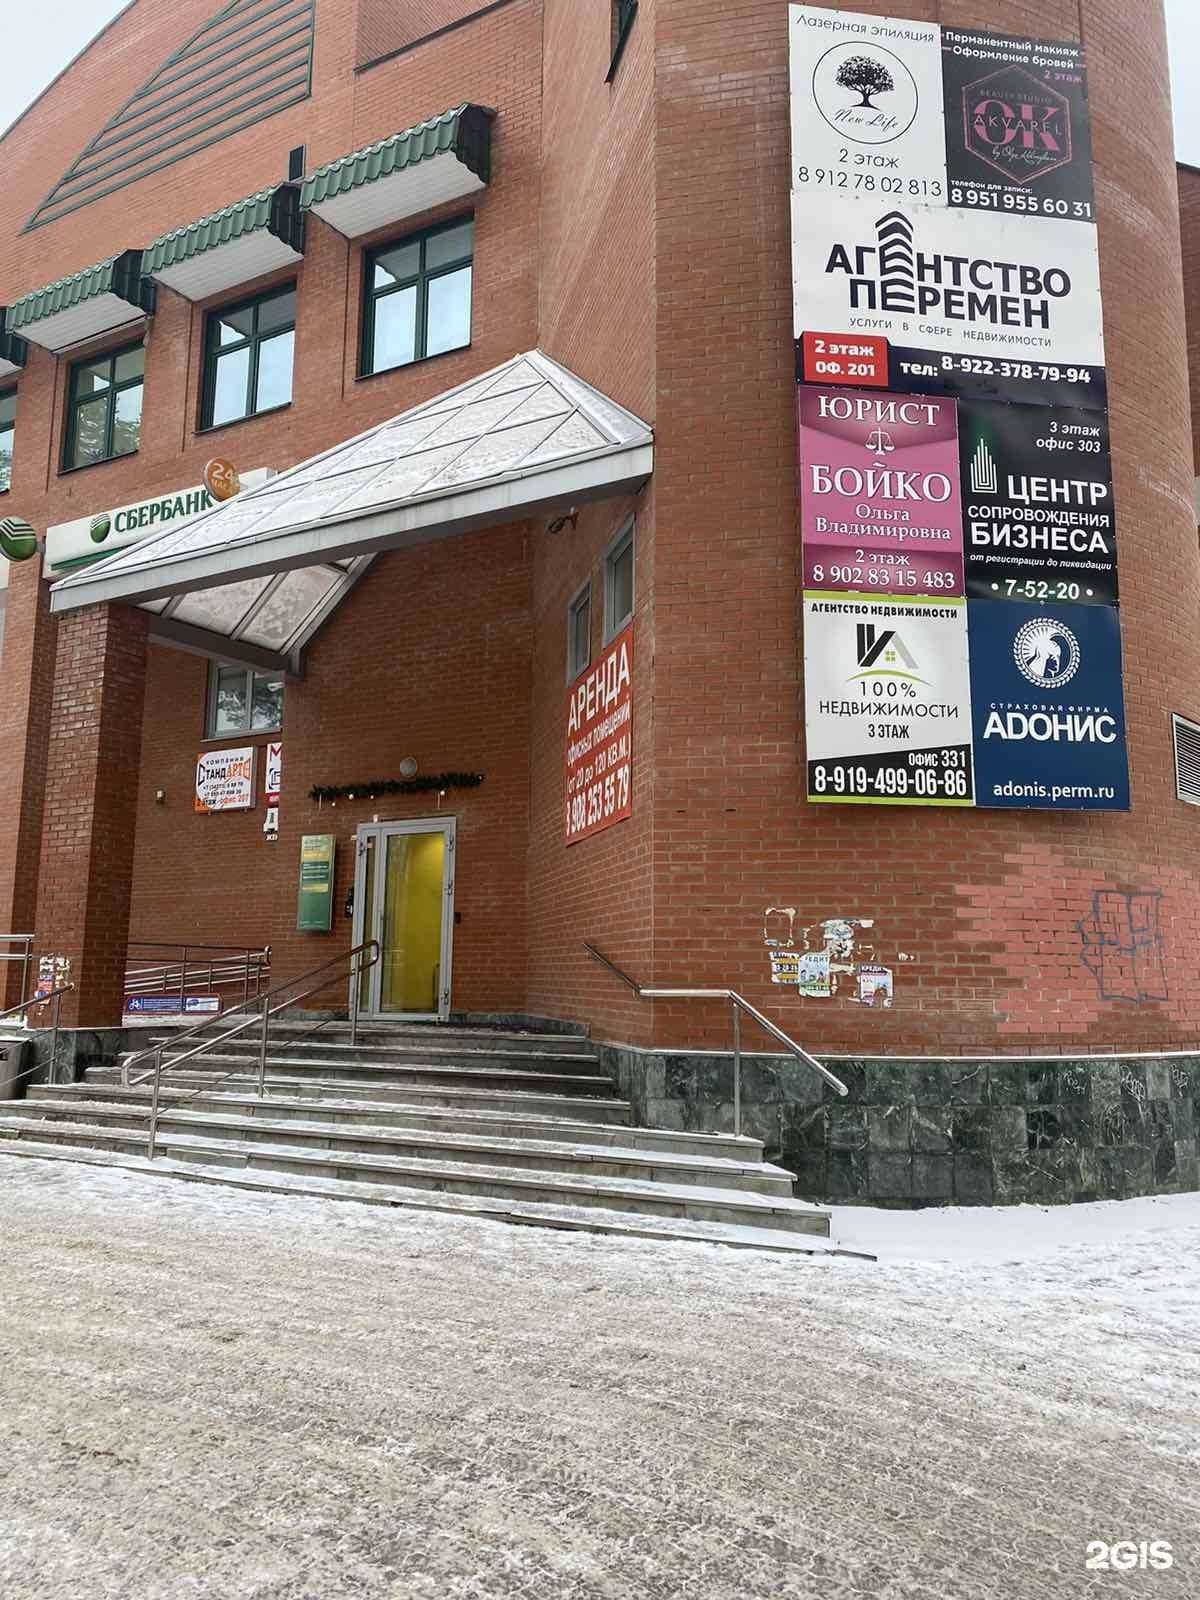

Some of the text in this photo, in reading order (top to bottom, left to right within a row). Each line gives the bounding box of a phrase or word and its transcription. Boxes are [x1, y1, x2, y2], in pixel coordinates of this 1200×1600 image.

[796, 13, 935, 42] Лазерная эпиляция
[946, 32, 1079, 57] Перманентный макияж
[952, 45, 1074, 70] Оформление бровей
[1044, 70, 1050, 80] 2
[834, 108, 899, 132] New Life
[840, 148, 900, 168] 2 этаж
[798, 166, 942, 197] 8 912 78 02 813
[951, 180, 985, 190] телефон
[952, 188, 1092, 218] 8 951 955 60 31
[825, 211, 1072, 298] АГЕНТСТВО
[850, 278, 1050, 329] ПЕРЕМЕН
[850, 318, 1052, 348] УСЛУГИ В СФЕРЕ НЕДВИЖИМОСТИ
[814, 340, 874, 358] 2 этаж
[816, 362, 875, 377] ОФ. 201
[900, 355, 1091, 384] тел: 8-922-378-79-94
[818, 395, 940, 426] ЮРИСТ
[1050, 421, 1100, 438] 3 этаж
[1036, 437, 1102, 454] офис 303
[810, 462, 952, 502] БОЙКО
[1007, 474, 1108, 506] ЦЕНТР
[114, 489, 214, 532] СБЕРБАНК
[856, 504, 910, 522] Ольга
[968, 505, 1110, 528] СОПРОВОЖДЕНИЯ
[816, 517, 952, 541] Владимировна
[971, 522, 1110, 554] БИЗНЕСА
[855, 550, 910, 566] 2 этаж
[970, 554, 1112, 570] от регистрации до ликвидации
[813, 564, 956, 589] 8 902 83 15 483
[1004, 578, 1080, 600] 7-52-20
[812, 602, 958, 618] АГЕНТСТВО НЕДВИЖИМОСТИ
[567, 640, 631, 737] АРЕНДА
[860, 681, 917, 698] 100%
[819, 700, 959, 718] НЕДВИЖИМОСТИ
[990, 702, 1064, 712] СТРАХОВАЯ
[868, 724, 910, 739] 3 ЭТАЖ
[908, 750, 966, 768] ОФИС 331
[814, 765, 967, 796] 8-919-499-06-86
[993, 780, 1115, 802] adonis.perm.ru
